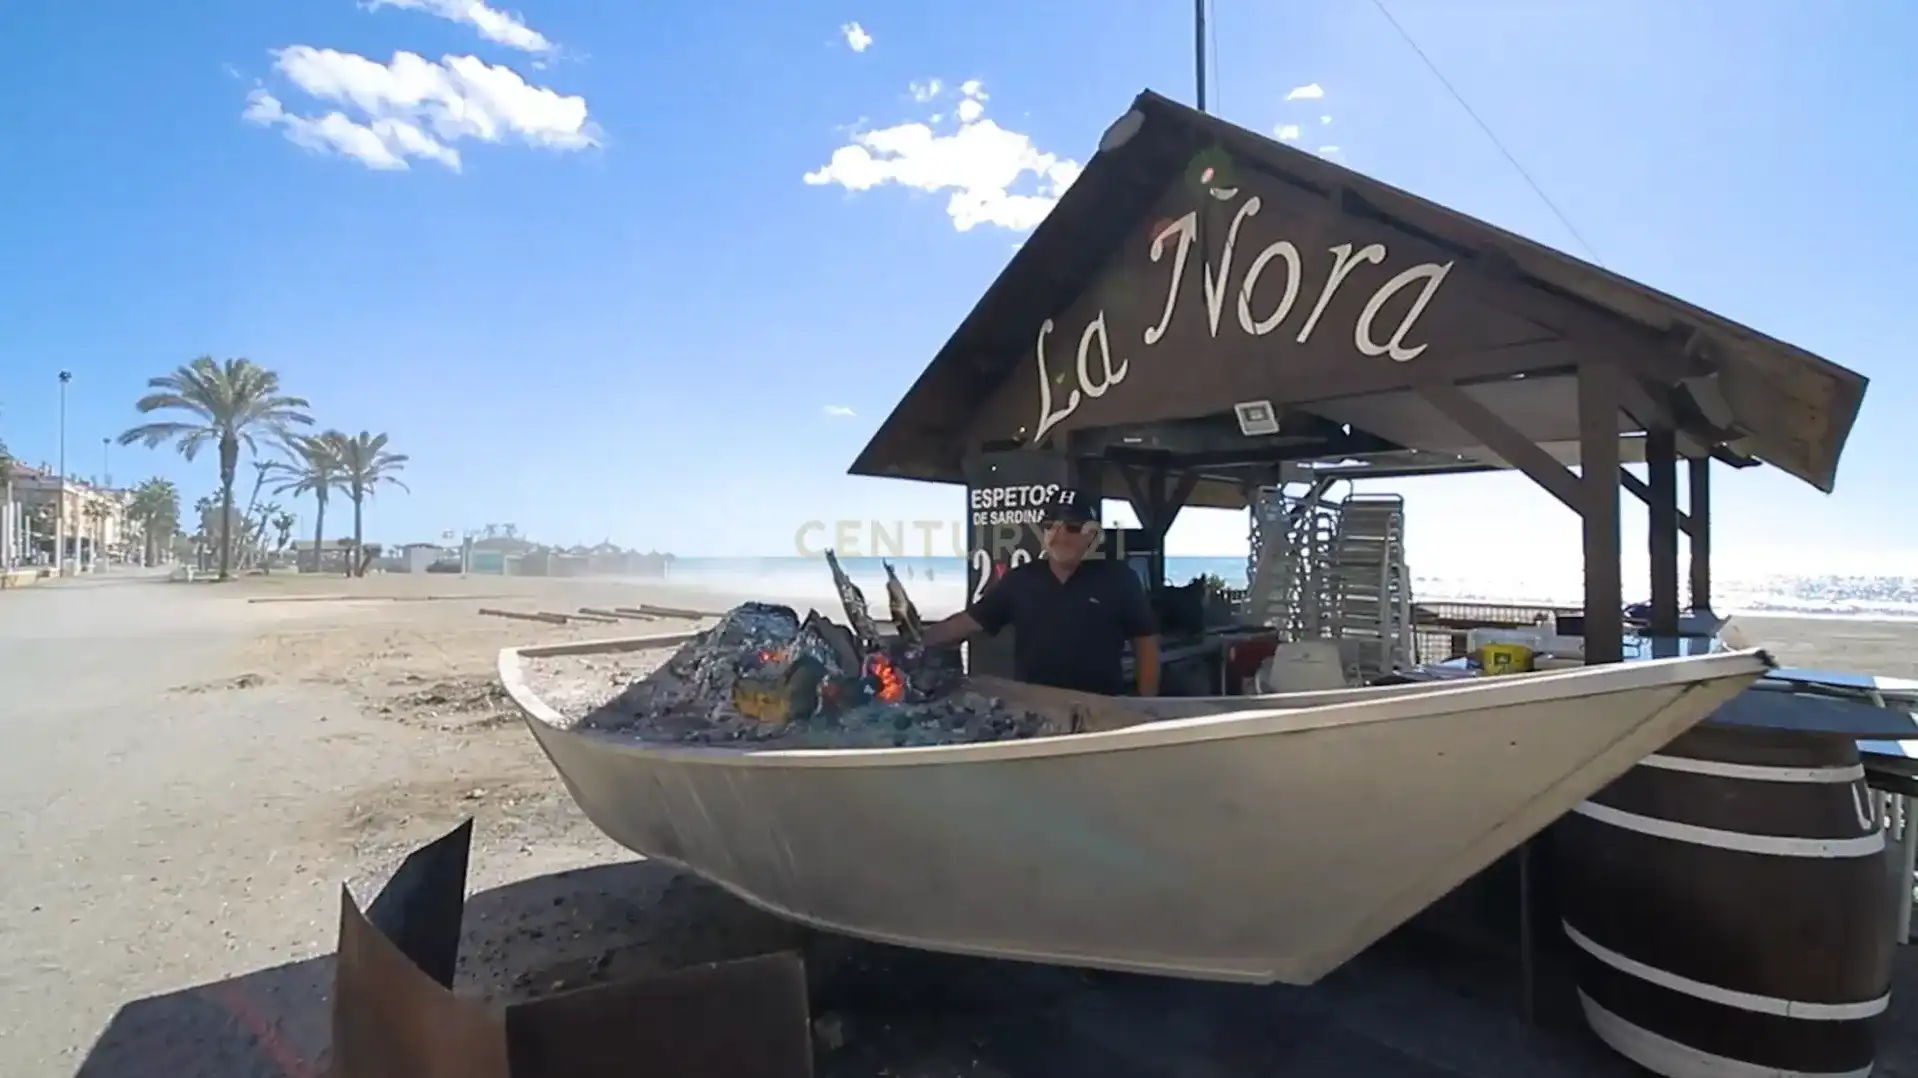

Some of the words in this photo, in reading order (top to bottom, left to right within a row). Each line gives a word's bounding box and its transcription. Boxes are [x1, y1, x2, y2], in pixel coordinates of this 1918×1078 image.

[1034, 310, 1128, 443] La
[1144, 167, 1454, 362] Ñora
[973, 511, 988, 526] DE
[990, 509, 1046, 525] SARDINA
